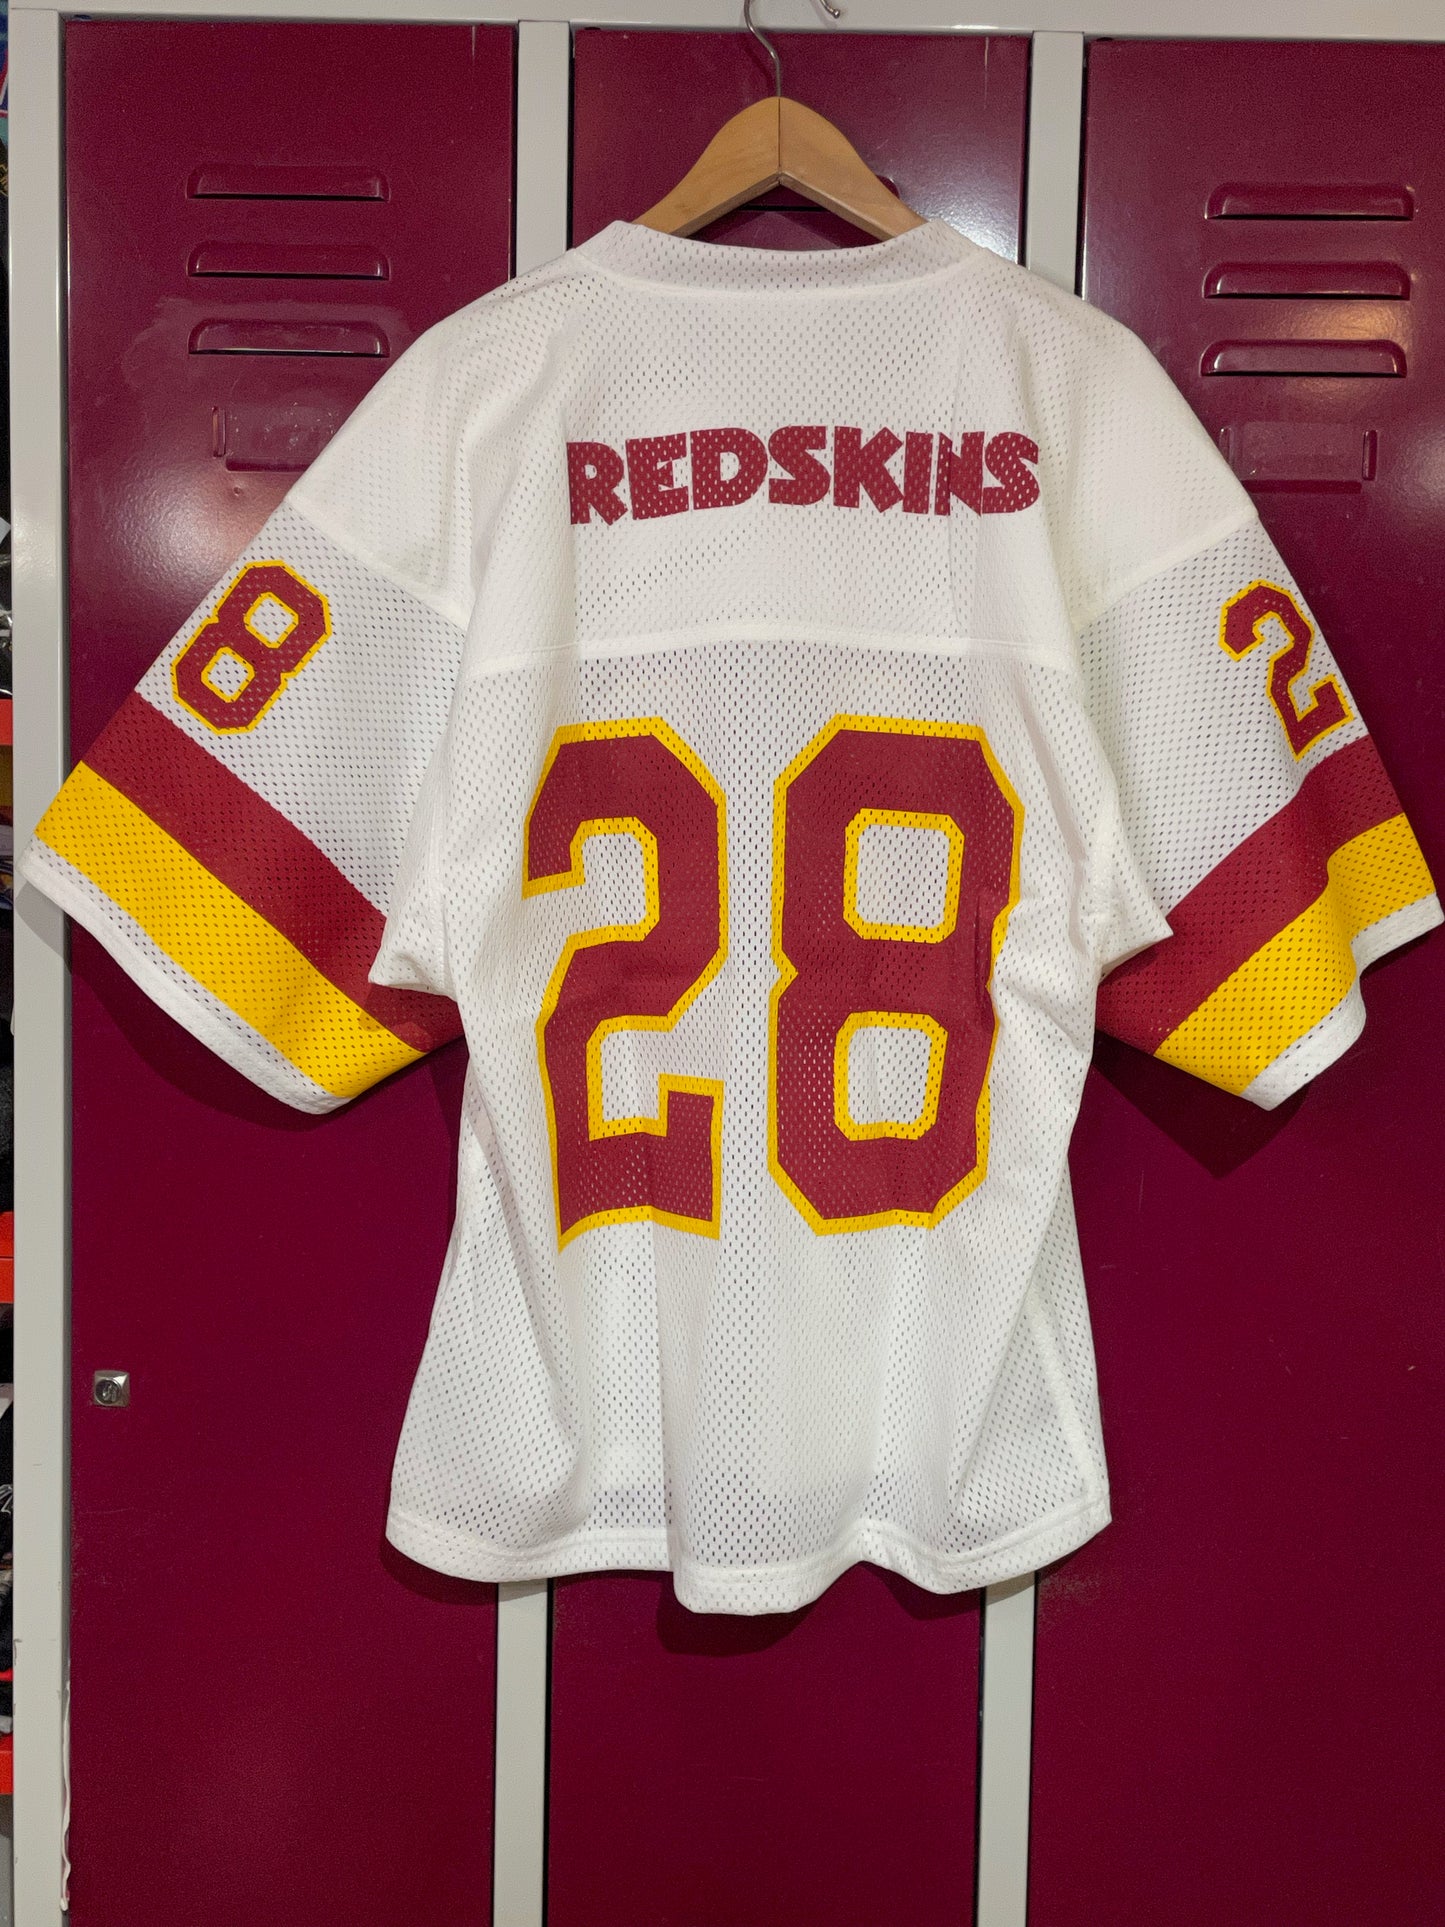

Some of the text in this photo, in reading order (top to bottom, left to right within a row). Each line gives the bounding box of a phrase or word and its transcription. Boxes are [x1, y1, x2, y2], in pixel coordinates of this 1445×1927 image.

[566, 425, 1041, 526] REDSKINS
[170, 559, 333, 736] 8
[1218, 579, 1355, 763] 2
[521, 713, 1026, 1256] 28
